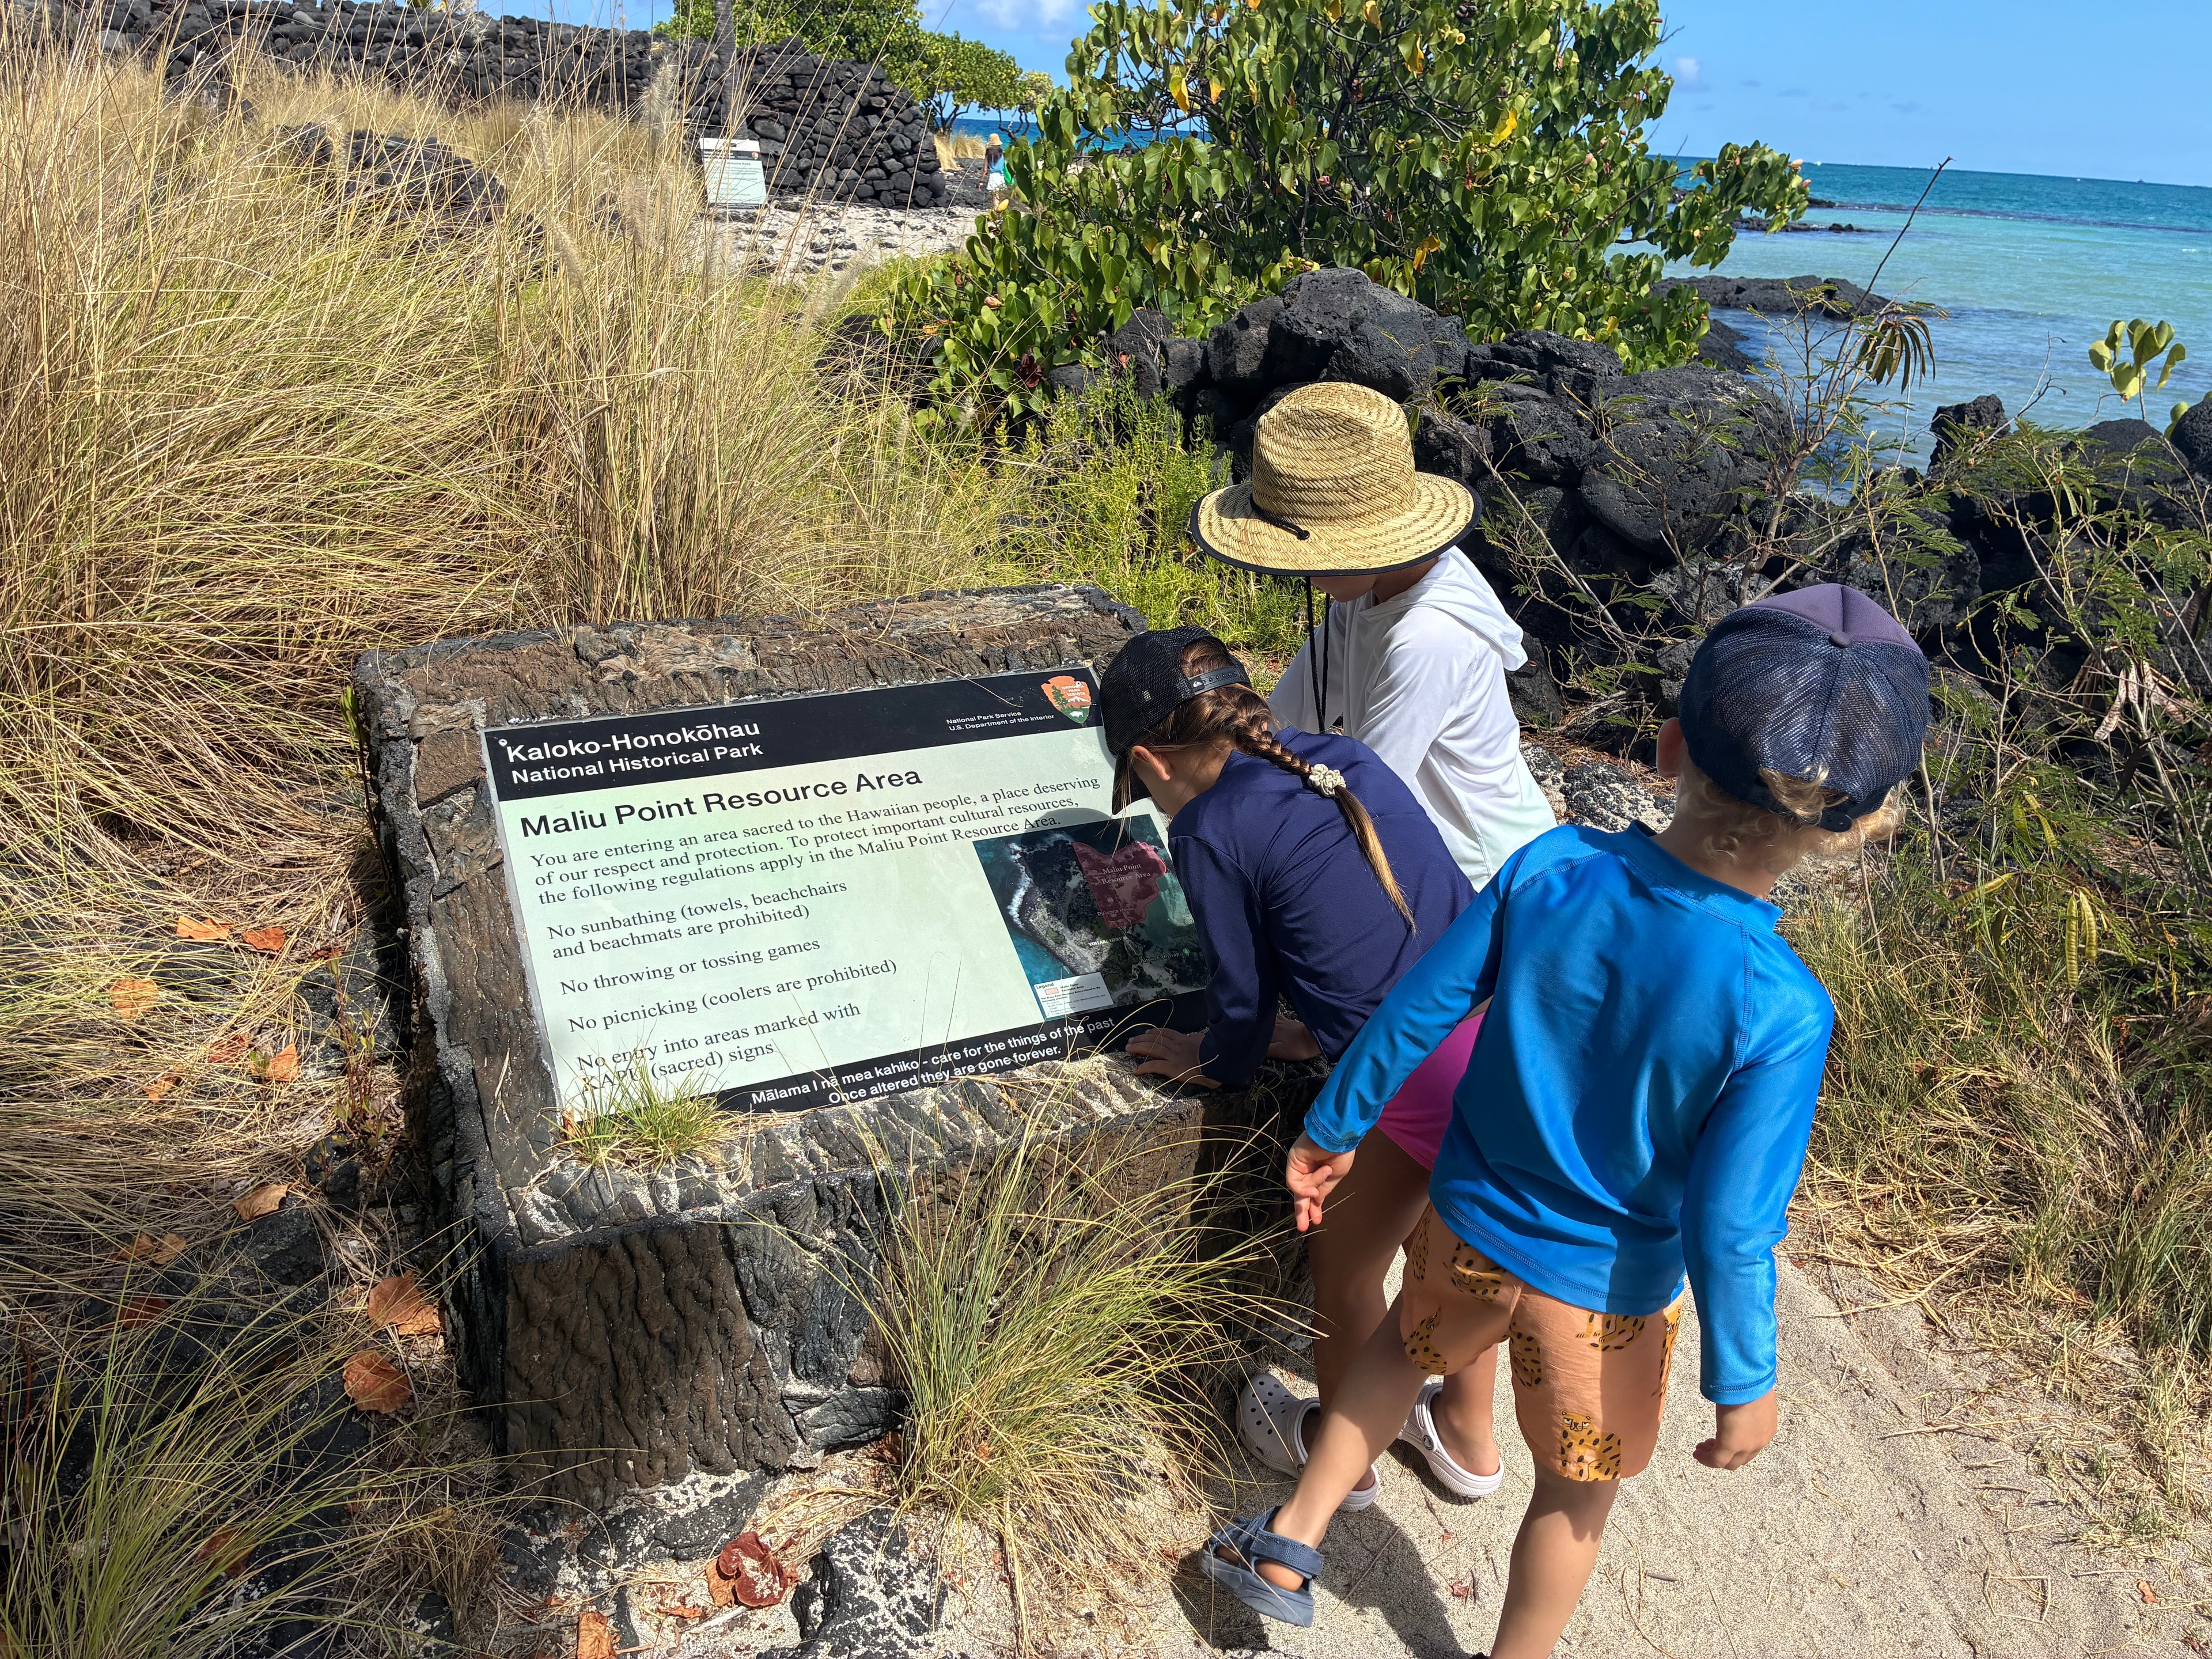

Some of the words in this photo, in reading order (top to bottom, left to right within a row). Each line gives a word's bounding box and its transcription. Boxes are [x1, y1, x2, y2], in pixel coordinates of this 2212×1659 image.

[507, 723, 760, 763] Kaloko-Honokōhau
[946, 716, 976, 725] National
[964, 720, 1009, 730] Department
[512, 760, 604, 784] National
[609, 748, 710, 772] Historical
[714, 743, 764, 760] Park
[520, 810, 607, 838] Maliu
[615, 797, 698, 825] Point
[703, 781, 848, 813] Resource
[856, 771, 923, 793] Area
[529, 854, 567, 868] You
[573, 850, 599, 862] are
[604, 839, 675, 857] entering
[679, 836, 699, 849] an
[703, 831, 738, 843] area
[743, 819, 794, 838] sacred
[798, 819, 814, 829] to
[817, 814, 843, 826] the
[846, 804, 920, 822] Hawaiian
[922, 794, 977, 814] people,
[980, 794, 990, 802] a
[991, 788, 1030, 804] place
[1033, 778, 1101, 794] deserving
[535, 871, 555, 886] of
[559, 870, 588, 882] our
[593, 858, 656, 877] respect
[660, 846, 691, 868] and
[695, 842, 783, 866] protection.
[786, 836, 809, 848] To
[813, 827, 869, 848] protect
[872, 816, 946, 836] important
[949, 805, 1005, 824] cultural
[1007, 798, 1078, 815] resources,
[539, 891, 566, 904] the
[571, 878, 658, 900] following
[661, 863, 755, 886] regulations
[760, 854, 803, 873] apply
[809, 851, 825, 863] in
[829, 847, 854, 859] the
[857, 839, 904, 855] Maliu
[907, 832, 949, 847] Point
[950, 823, 1020, 840] Resource
[1024, 817, 1060, 830] Area.
[1102, 866, 1123, 874] Maliu
[1101, 875, 1133, 885] Resource
[547, 925, 575, 940] No
[581, 910, 677, 934] sunbathing
[681, 897, 748, 921] (towels,
[751, 881, 847, 906] beachchairs
[553, 941, 586, 959] and
[589, 928, 682, 952] beachmats
[687, 923, 713, 936] are
[717, 904, 809, 934] prohibited)
[559, 979, 588, 995] No
[593, 966, 675, 989] throwing
[679, 962, 696, 974] or
[701, 950, 764, 969] tossing
[768, 941, 820, 961] games
[567, 1017, 597, 1032] No
[602, 999, 698, 1030] picnicking
[702, 986, 771, 1010] (coolers
[776, 980, 802, 993] are
[806, 959, 897, 991] prohibited)
[577, 1054, 606, 1071] No
[612, 1045, 658, 1064] entry
[664, 1038, 699, 1054] into
[704, 1028, 749, 1046] areas
[753, 1010, 819, 1036] marked
[822, 1003, 861, 1021] with
[651, 1051, 723, 1081] (sacred)
[729, 1044, 774, 1062] signs
[752, 1084, 811, 1104] Mālama
[821, 1075, 840, 1089] nā
[842, 1071, 874, 1085] mea
[874, 1060, 920, 1078] kahiko
[931, 1051, 961, 1066] care
[963, 1044, 982, 1059] for
[983, 1040, 1006, 1054] the
[1007, 1033, 1047, 1048] things
[1049, 1027, 1062, 1039] of
[1063, 1024, 1085, 1037] the
[1086, 1017, 1115, 1033] past
[828, 1087, 867, 1104] Once
[870, 1075, 918, 1093] altered
[921, 1069, 950, 1085] they
[953, 1065, 975, 1076] are
[978, 1057, 1012, 1073] gone
[1013, 1045, 1062, 1065] forever.
